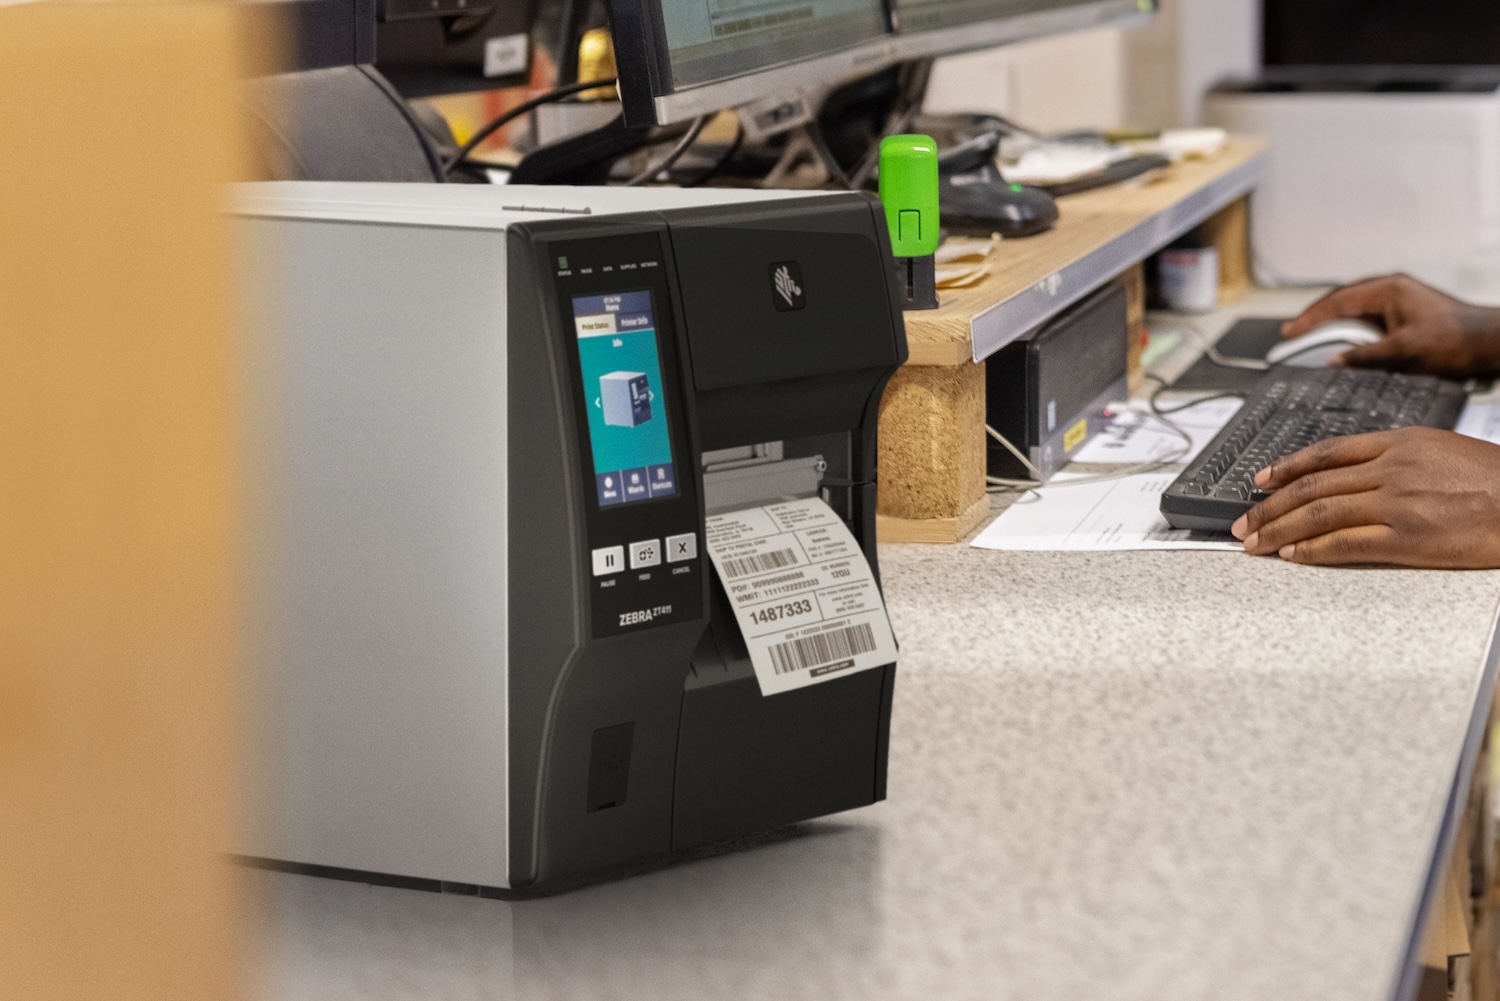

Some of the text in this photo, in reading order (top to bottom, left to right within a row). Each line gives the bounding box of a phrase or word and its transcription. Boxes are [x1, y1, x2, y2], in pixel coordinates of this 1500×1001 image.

[672, 566, 690, 575] CANCEL
[638, 573, 651, 581] FEED
[600, 579, 616, 588] PAUSE
[619, 604, 672, 627] ZEBRA ZT411
[749, 599, 812, 625] 1487333
